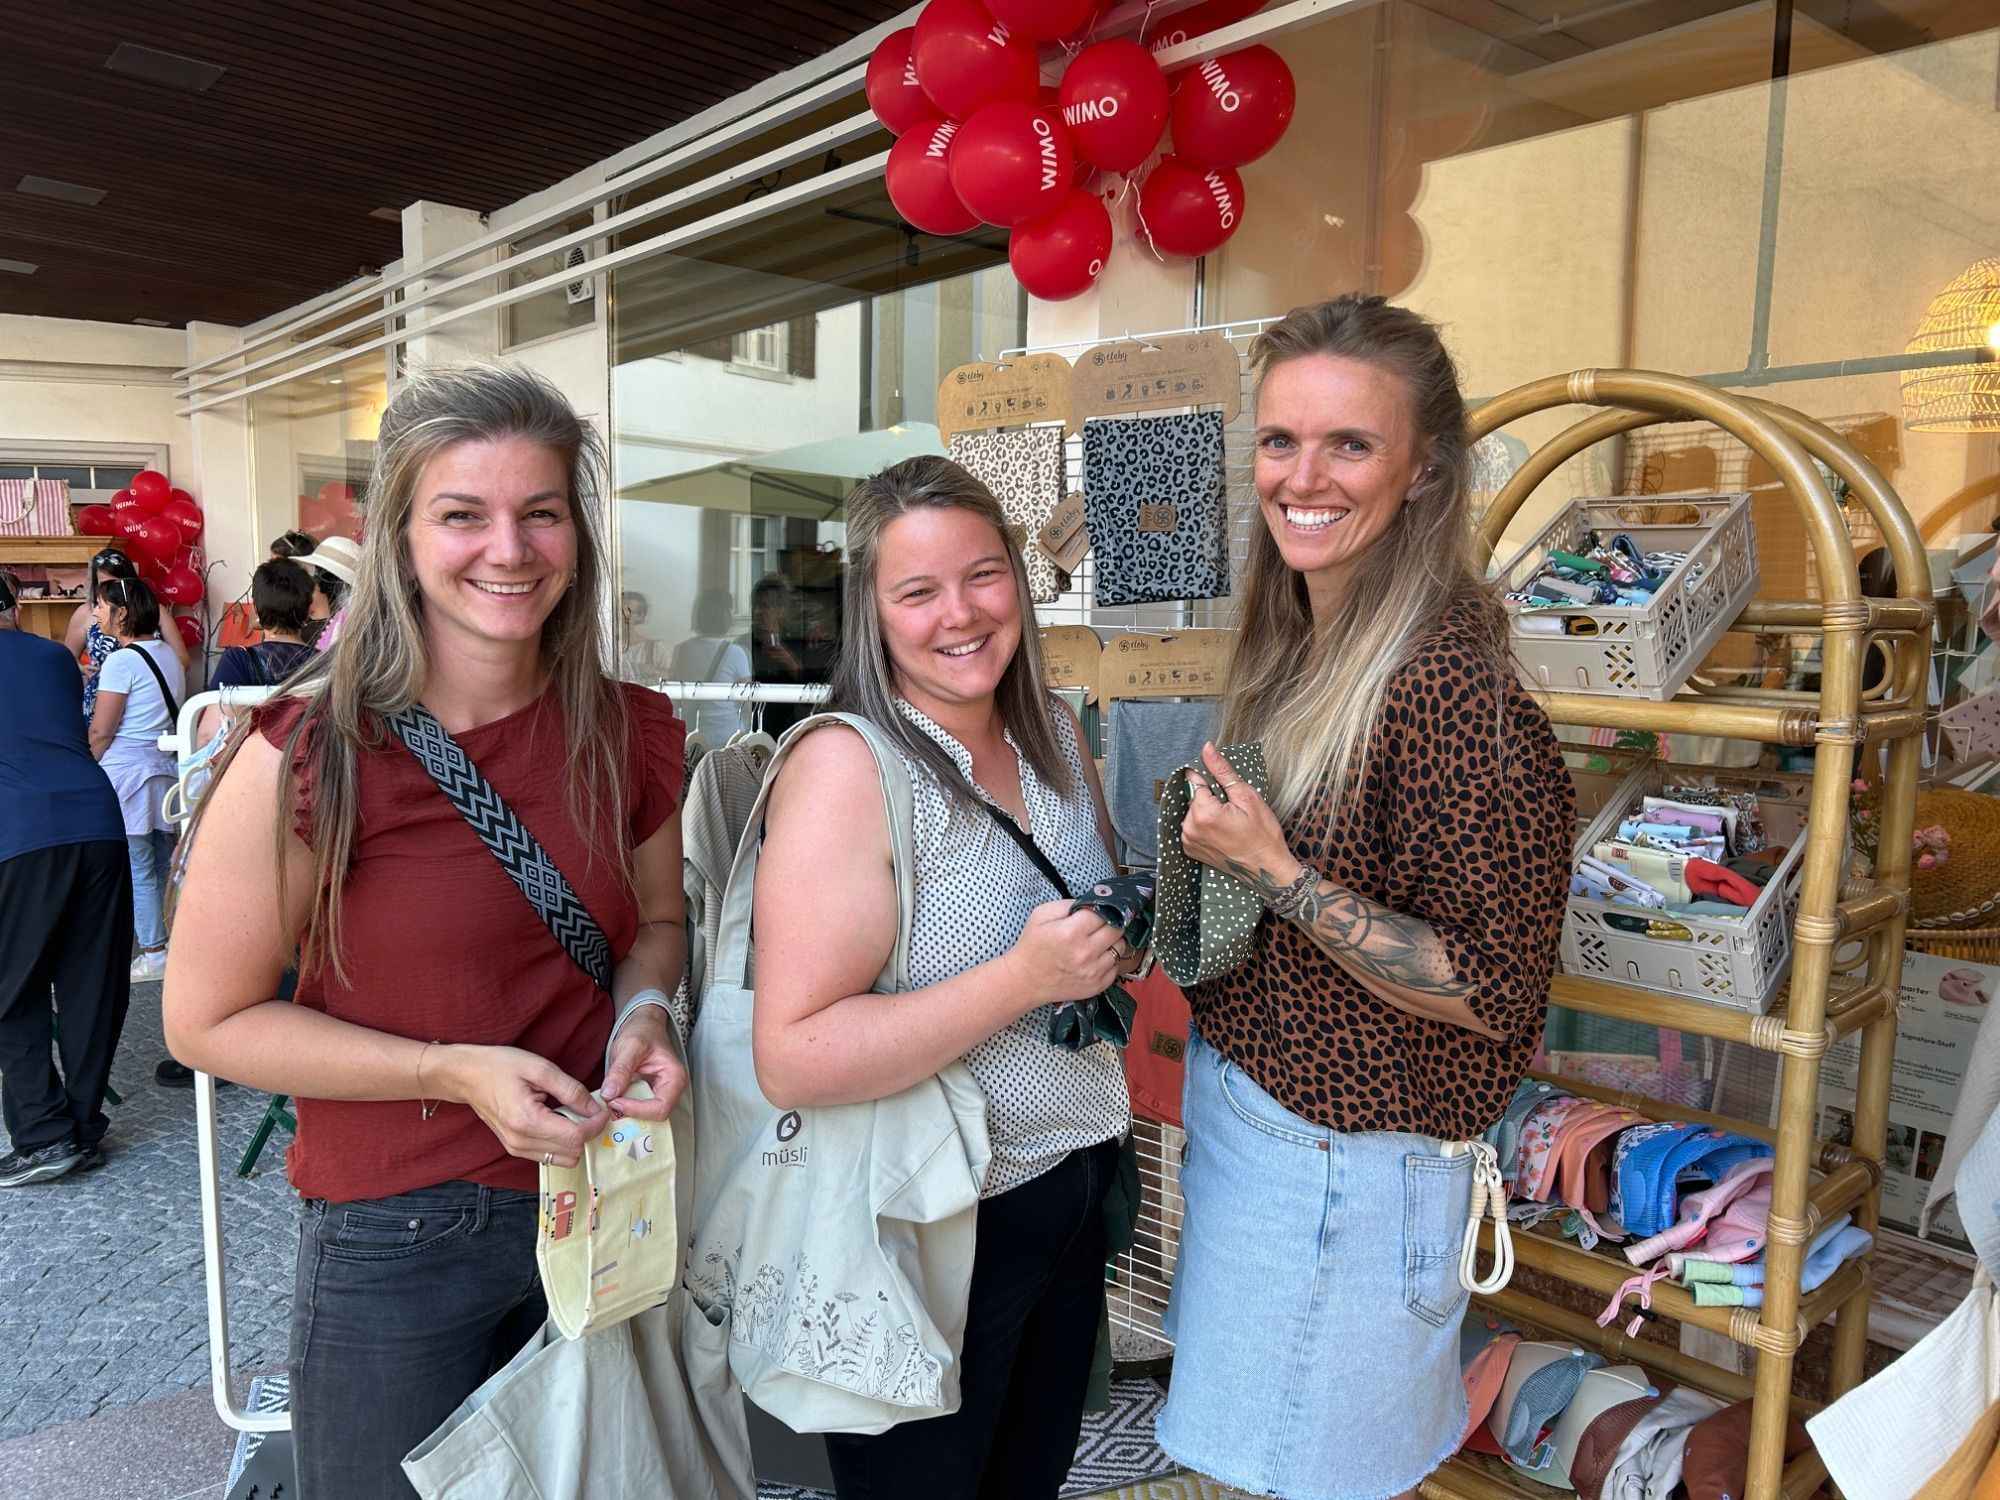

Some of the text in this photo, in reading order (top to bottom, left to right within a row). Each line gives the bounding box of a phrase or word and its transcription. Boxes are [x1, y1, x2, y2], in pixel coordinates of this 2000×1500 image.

[1150, 29, 1187, 53] IMO
[1200, 58, 1240, 113] WIMO
[1063, 96, 1118, 127] WIMO
[1032, 118, 1058, 191] WIMO
[1205, 169, 1234, 229] WIMO
[762, 1146, 808, 1166] müsli
